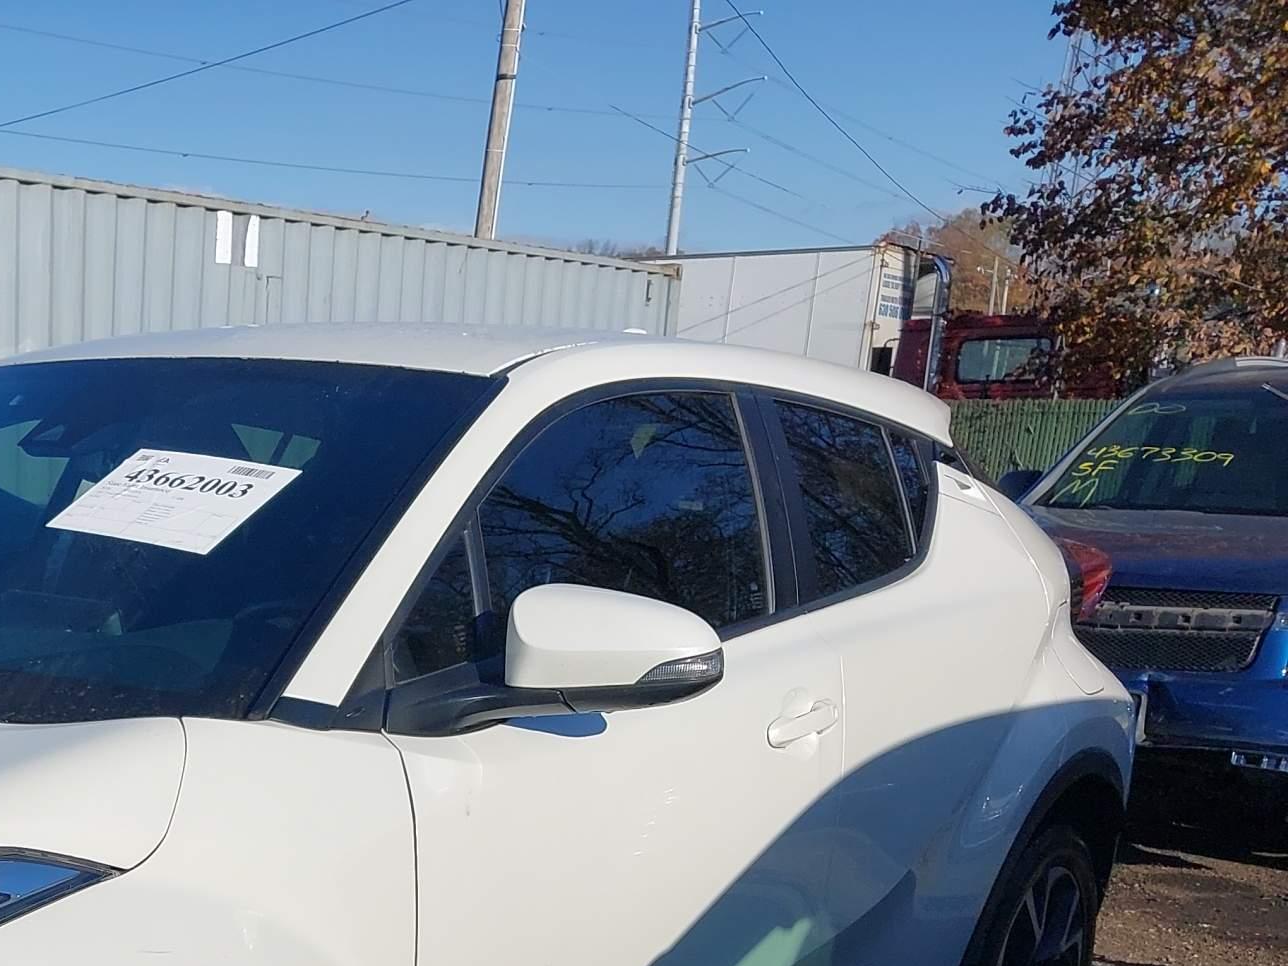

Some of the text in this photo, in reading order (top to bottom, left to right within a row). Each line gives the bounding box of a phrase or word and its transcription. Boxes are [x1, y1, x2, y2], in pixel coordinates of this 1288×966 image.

[1071, 459, 1120, 477] SF
[1087, 445, 1235, 468] 43673309
[123, 468, 254, 499] 43662003
